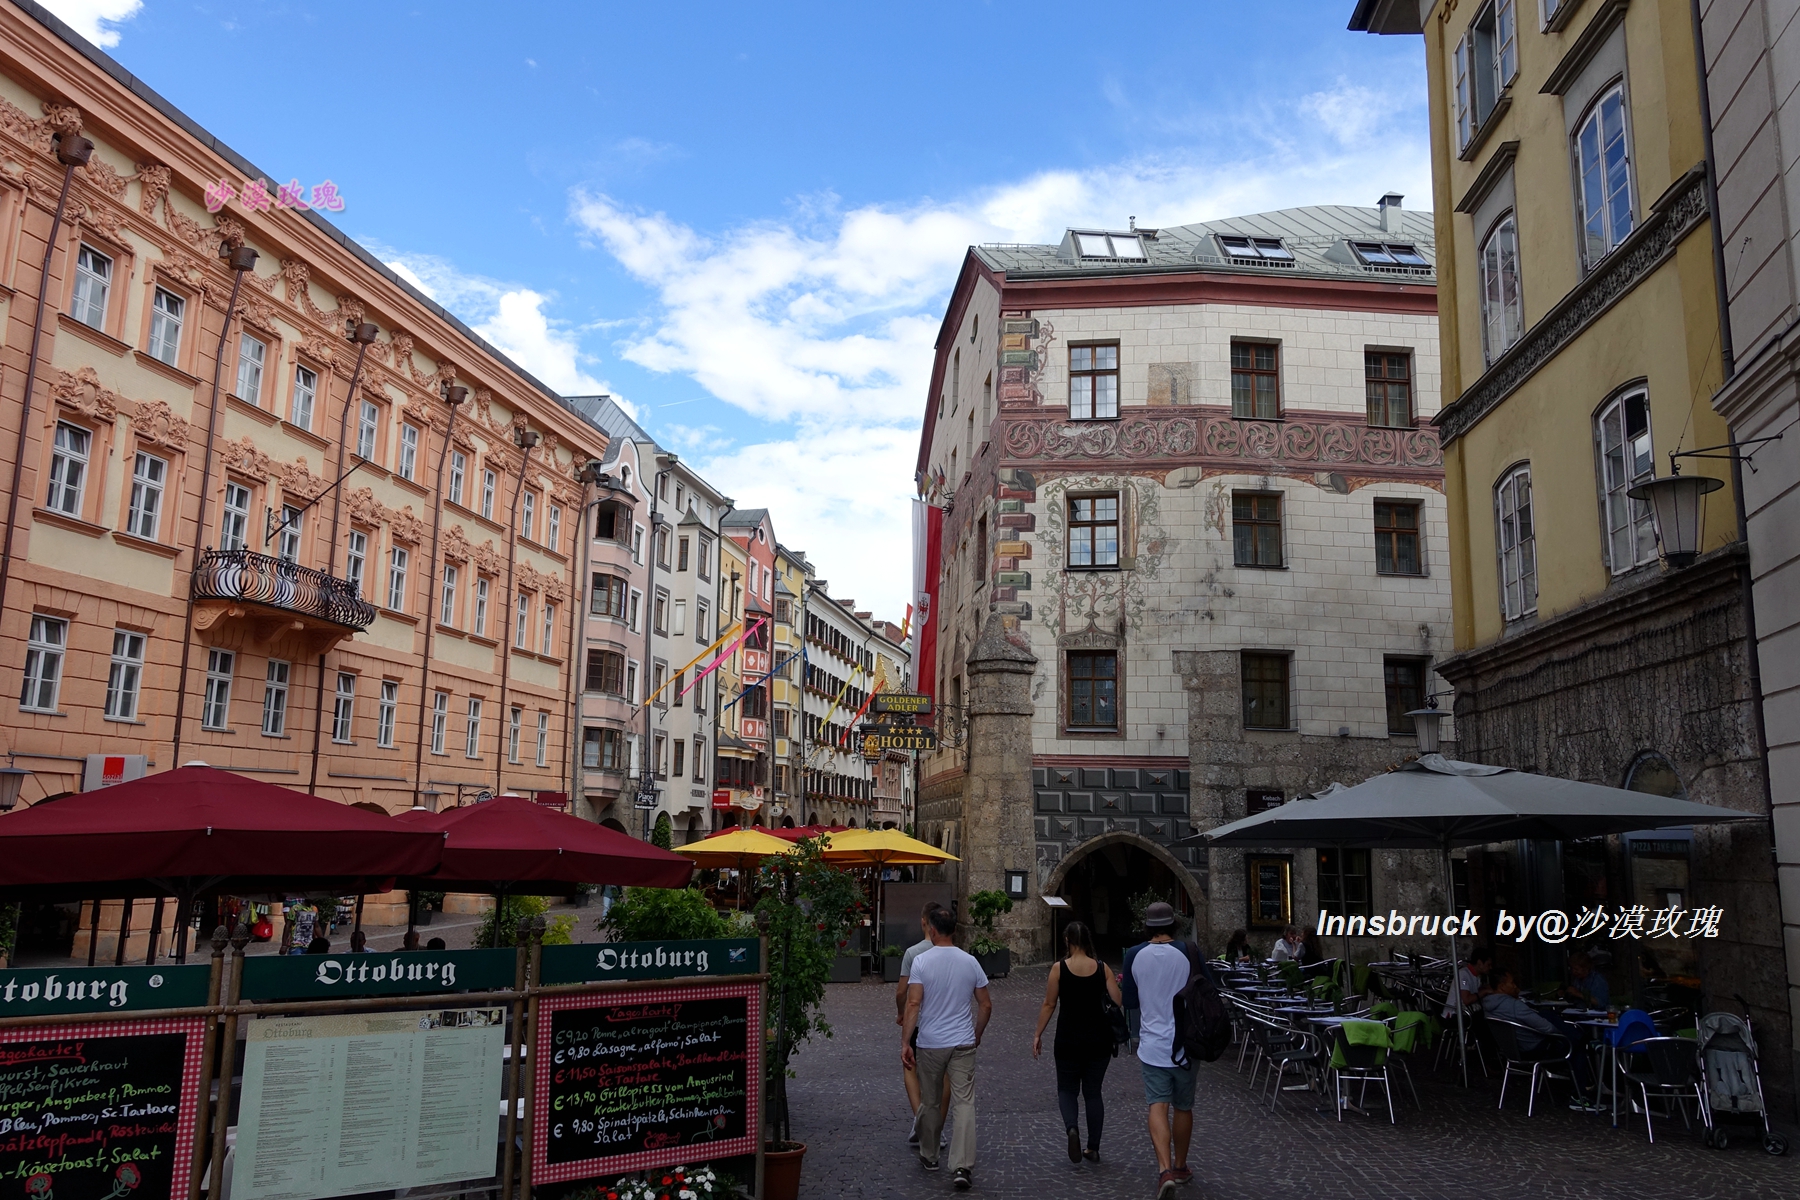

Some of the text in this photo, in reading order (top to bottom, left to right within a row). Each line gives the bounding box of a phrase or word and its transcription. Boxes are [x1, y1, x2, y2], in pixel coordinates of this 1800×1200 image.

[880, 697, 928, 705] GOLDENER
[886, 704, 919, 712] ADLER
[880, 736, 935, 749] HOTEL
[637, 792, 654, 802] Piano
[1632, 842, 1652, 852] PIZZA
[1652, 842, 1671, 853] TAKE
[596, 947, 709, 972] Ottoburg
[315, 958, 457, 987] Ottoburg
[0, 974, 129, 1007] toburg
[263, 1027, 313, 1039] Ottoburg
[591, 1026, 617, 1041] Penne
[47, 1056, 129, 1078] Sauerkraut
[121, 1083, 172, 1098] Pommes
[664, 1084, 684, 1093] vom
[593, 1126, 633, 1144] Salat
[110, 1144, 162, 1164] Salat
